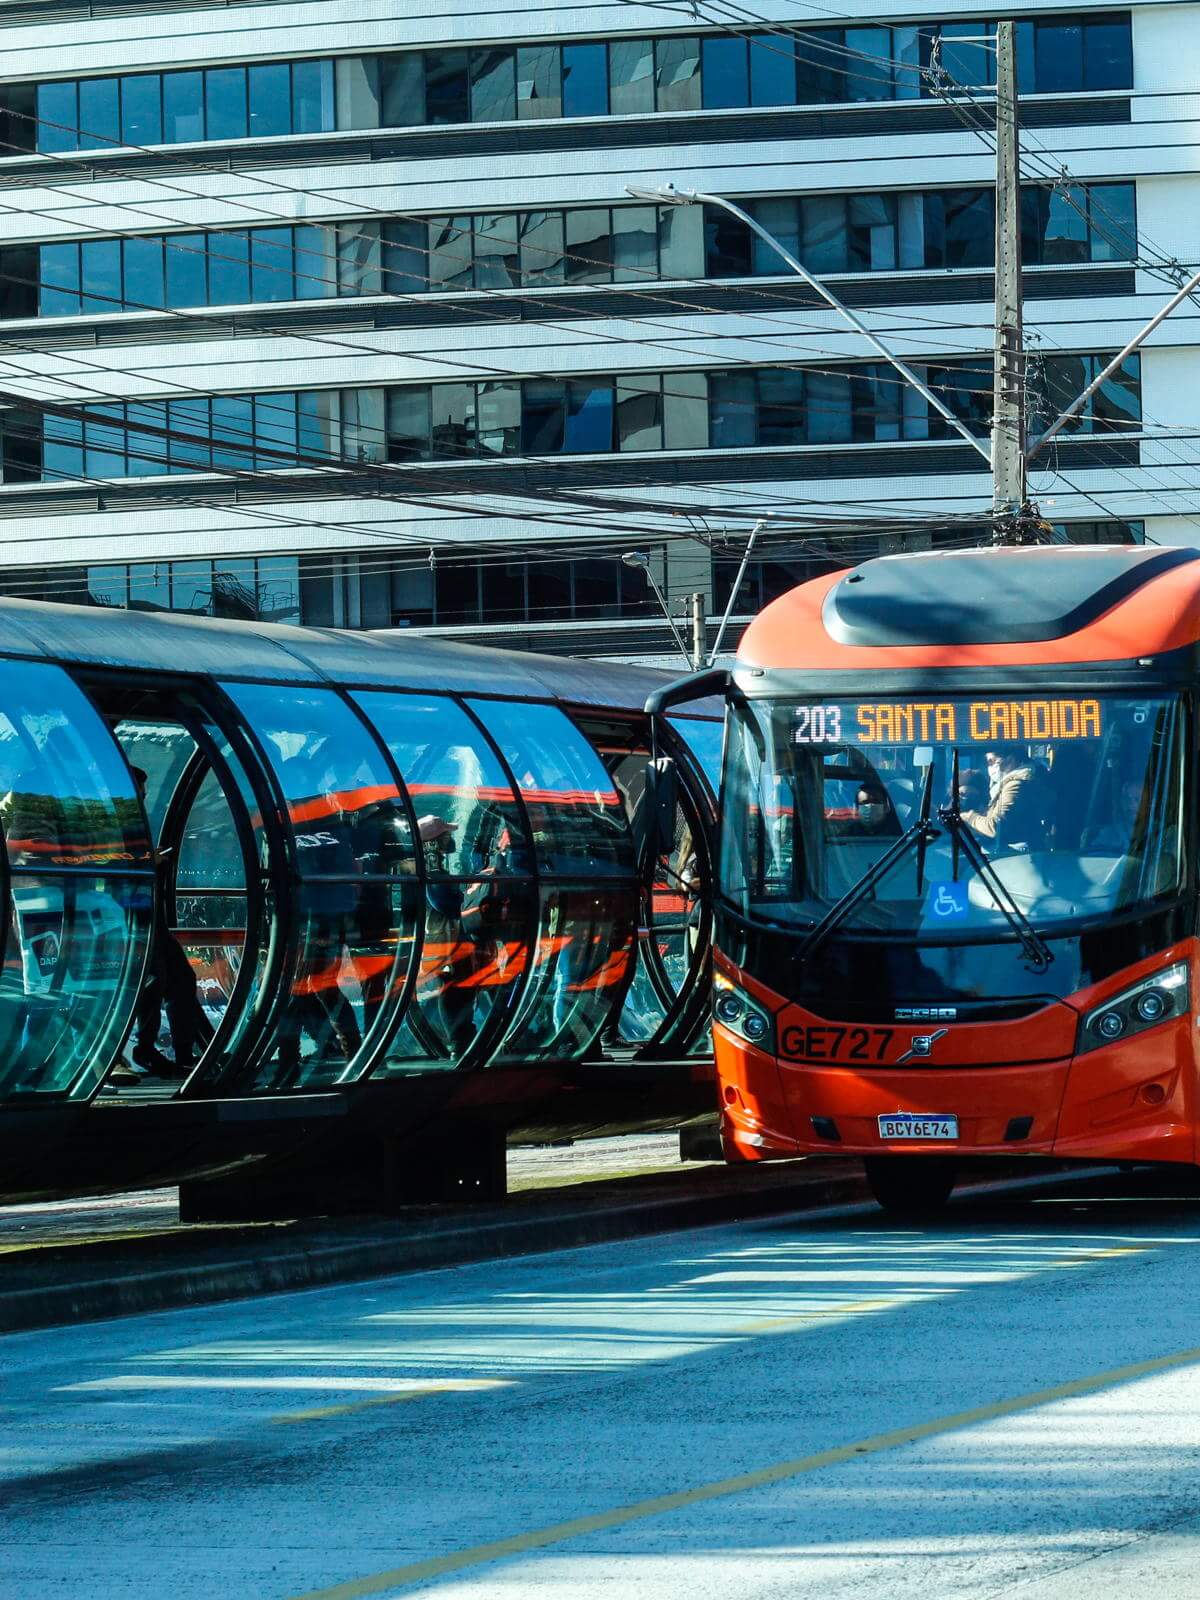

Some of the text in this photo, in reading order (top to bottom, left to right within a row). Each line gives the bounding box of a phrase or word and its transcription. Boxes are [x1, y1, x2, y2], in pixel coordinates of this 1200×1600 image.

[794, 699, 1101, 743] 203 SANTA CANDIDA
[781, 1025, 895, 1060] GE727
[886, 1122, 949, 1136] BCY6E74
